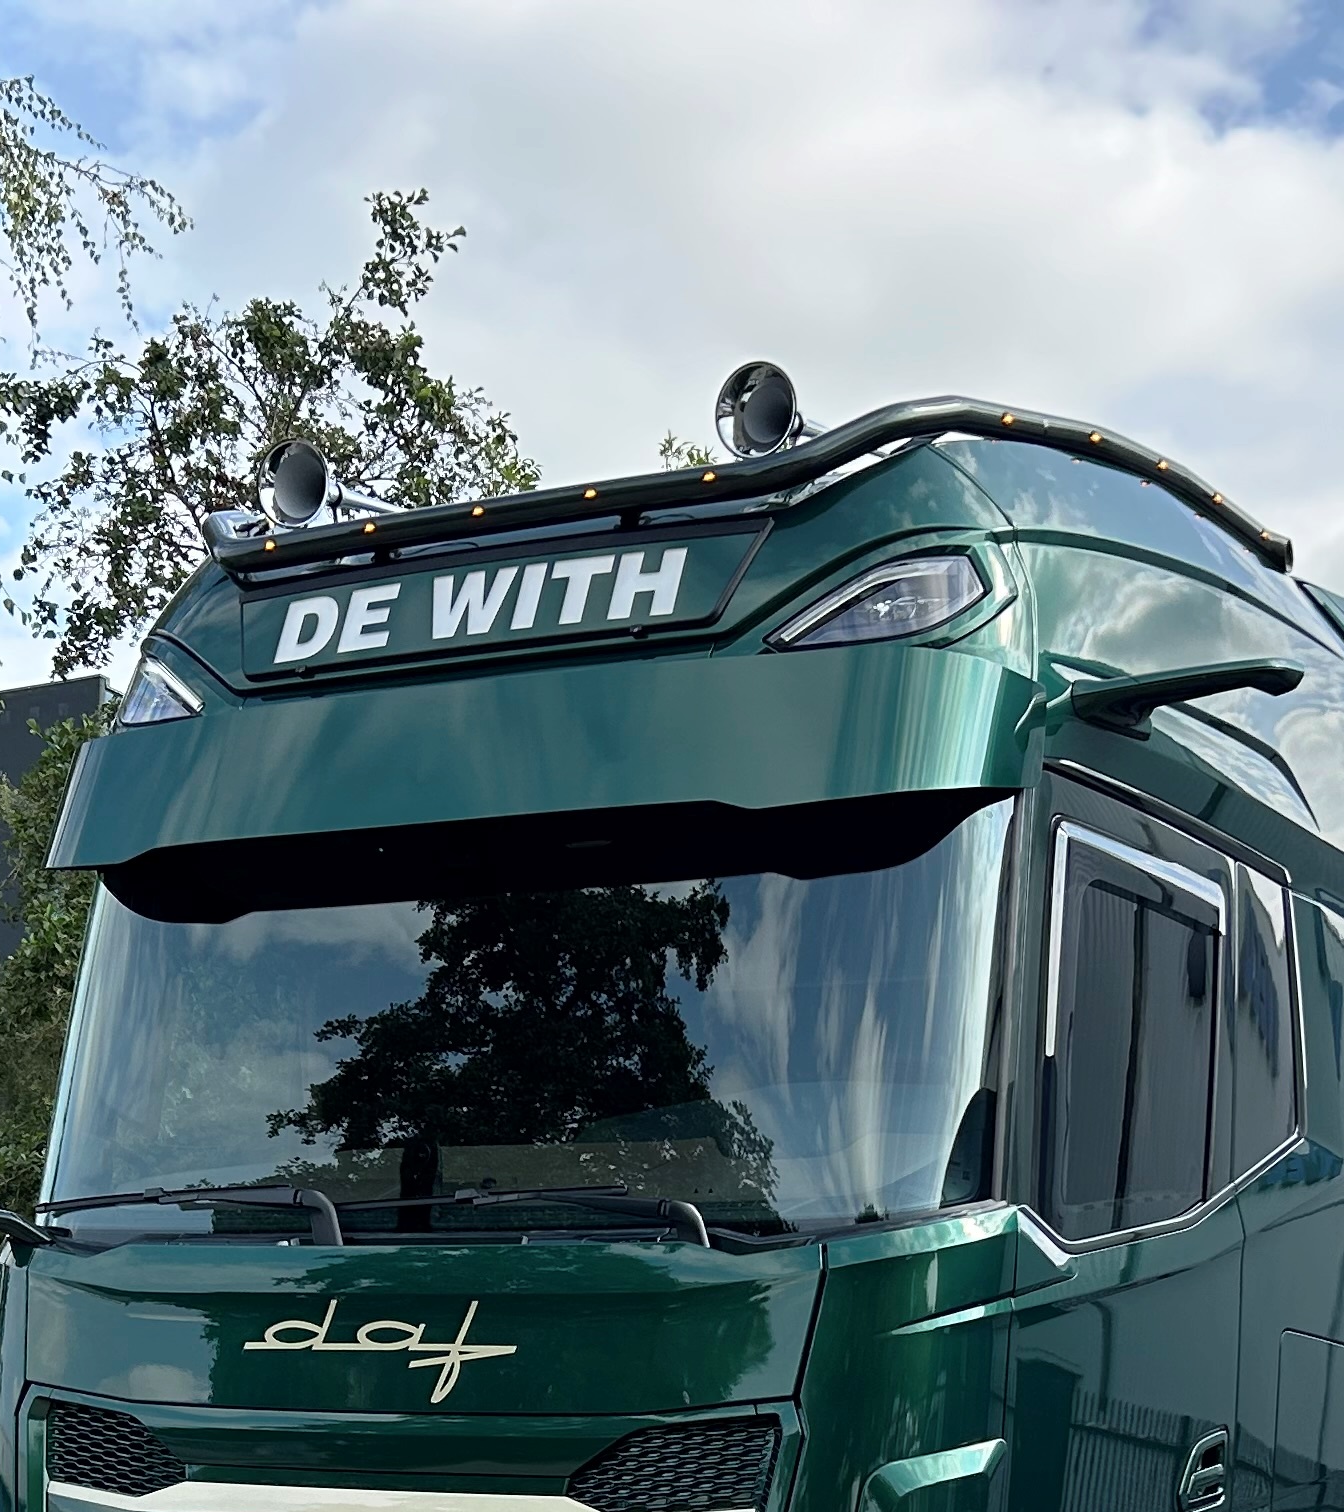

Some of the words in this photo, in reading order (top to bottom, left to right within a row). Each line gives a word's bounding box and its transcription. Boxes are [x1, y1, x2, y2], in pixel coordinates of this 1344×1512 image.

[272, 583, 401, 664] DE
[431, 547, 689, 640] WITH
[242, 1299, 518, 1404] daf
